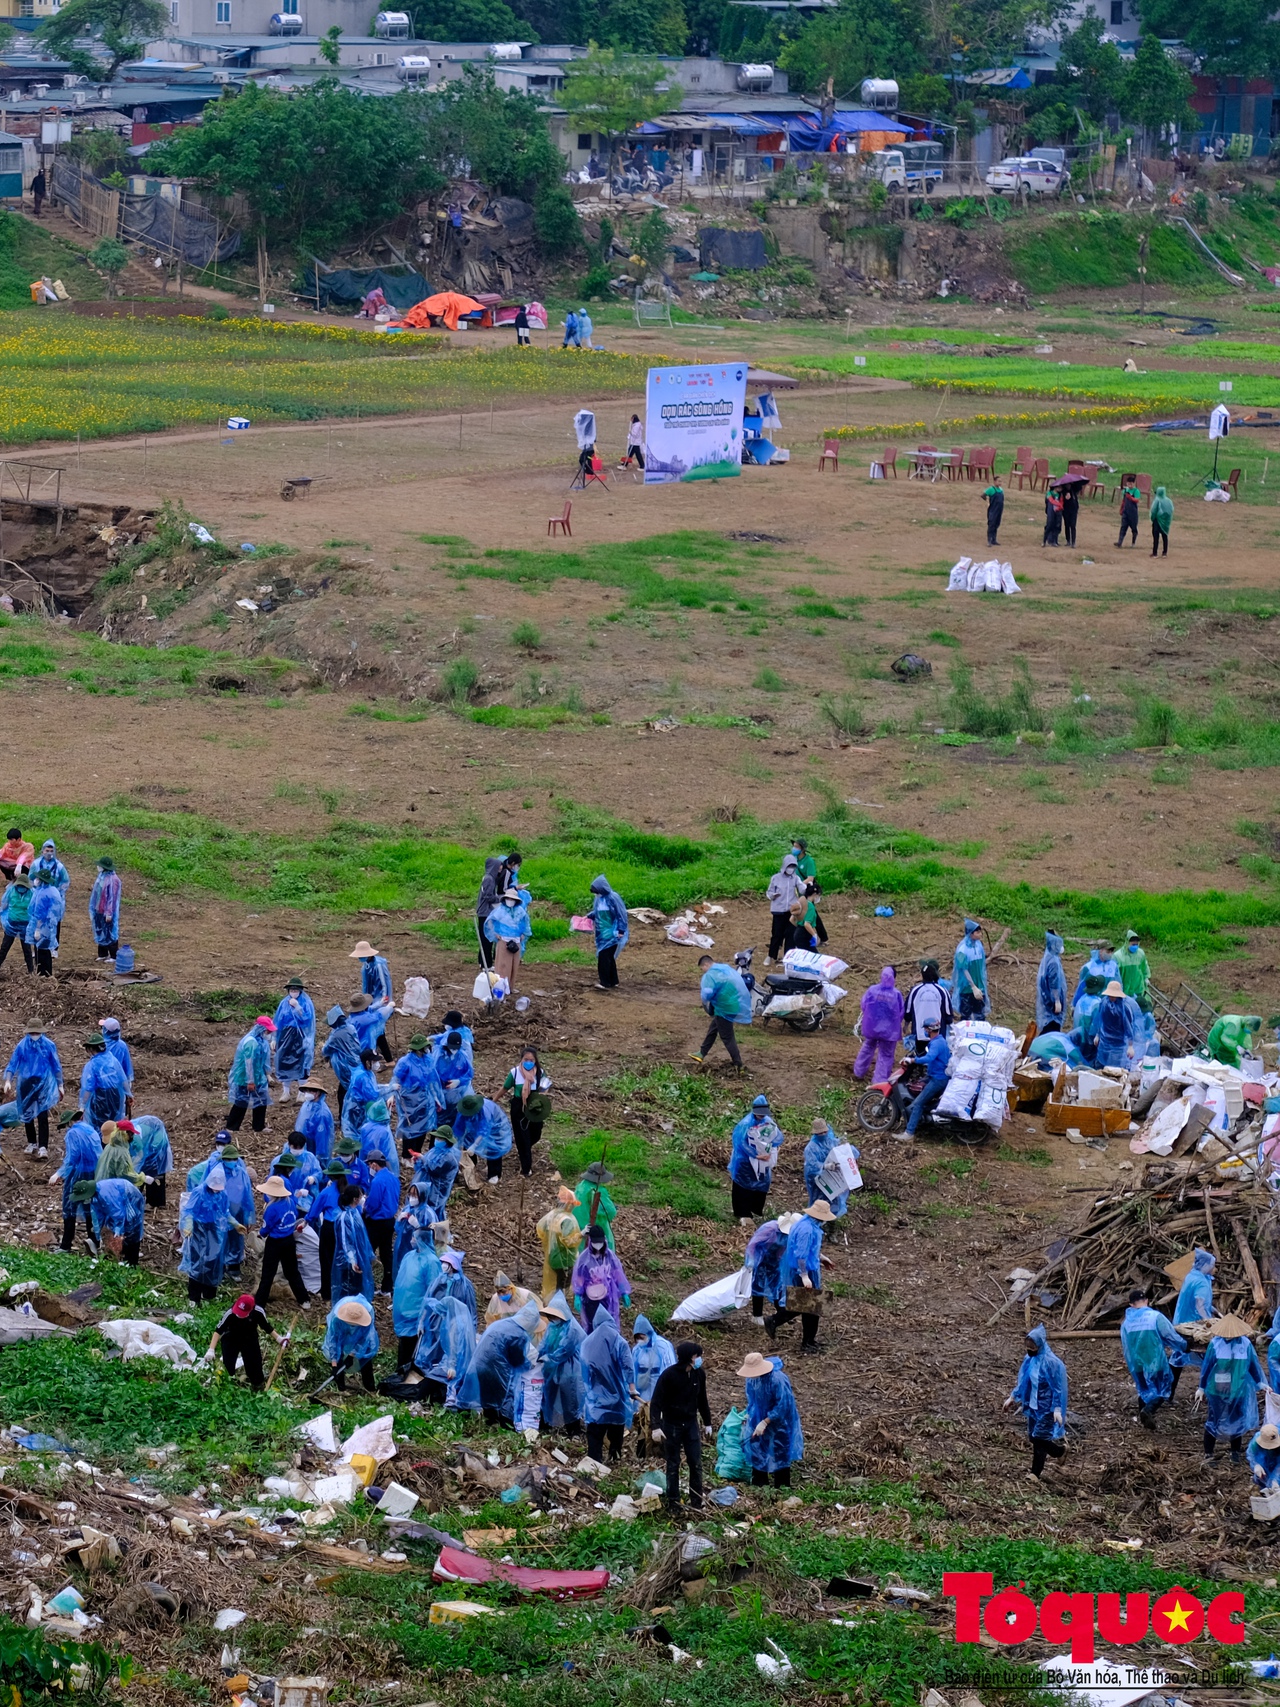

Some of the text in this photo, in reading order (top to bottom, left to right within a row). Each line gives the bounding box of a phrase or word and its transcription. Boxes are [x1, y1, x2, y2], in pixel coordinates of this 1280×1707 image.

[661, 405, 677, 420] DỌN
[678, 402, 693, 418] RÁC
[693, 401, 713, 417] SÔNG
